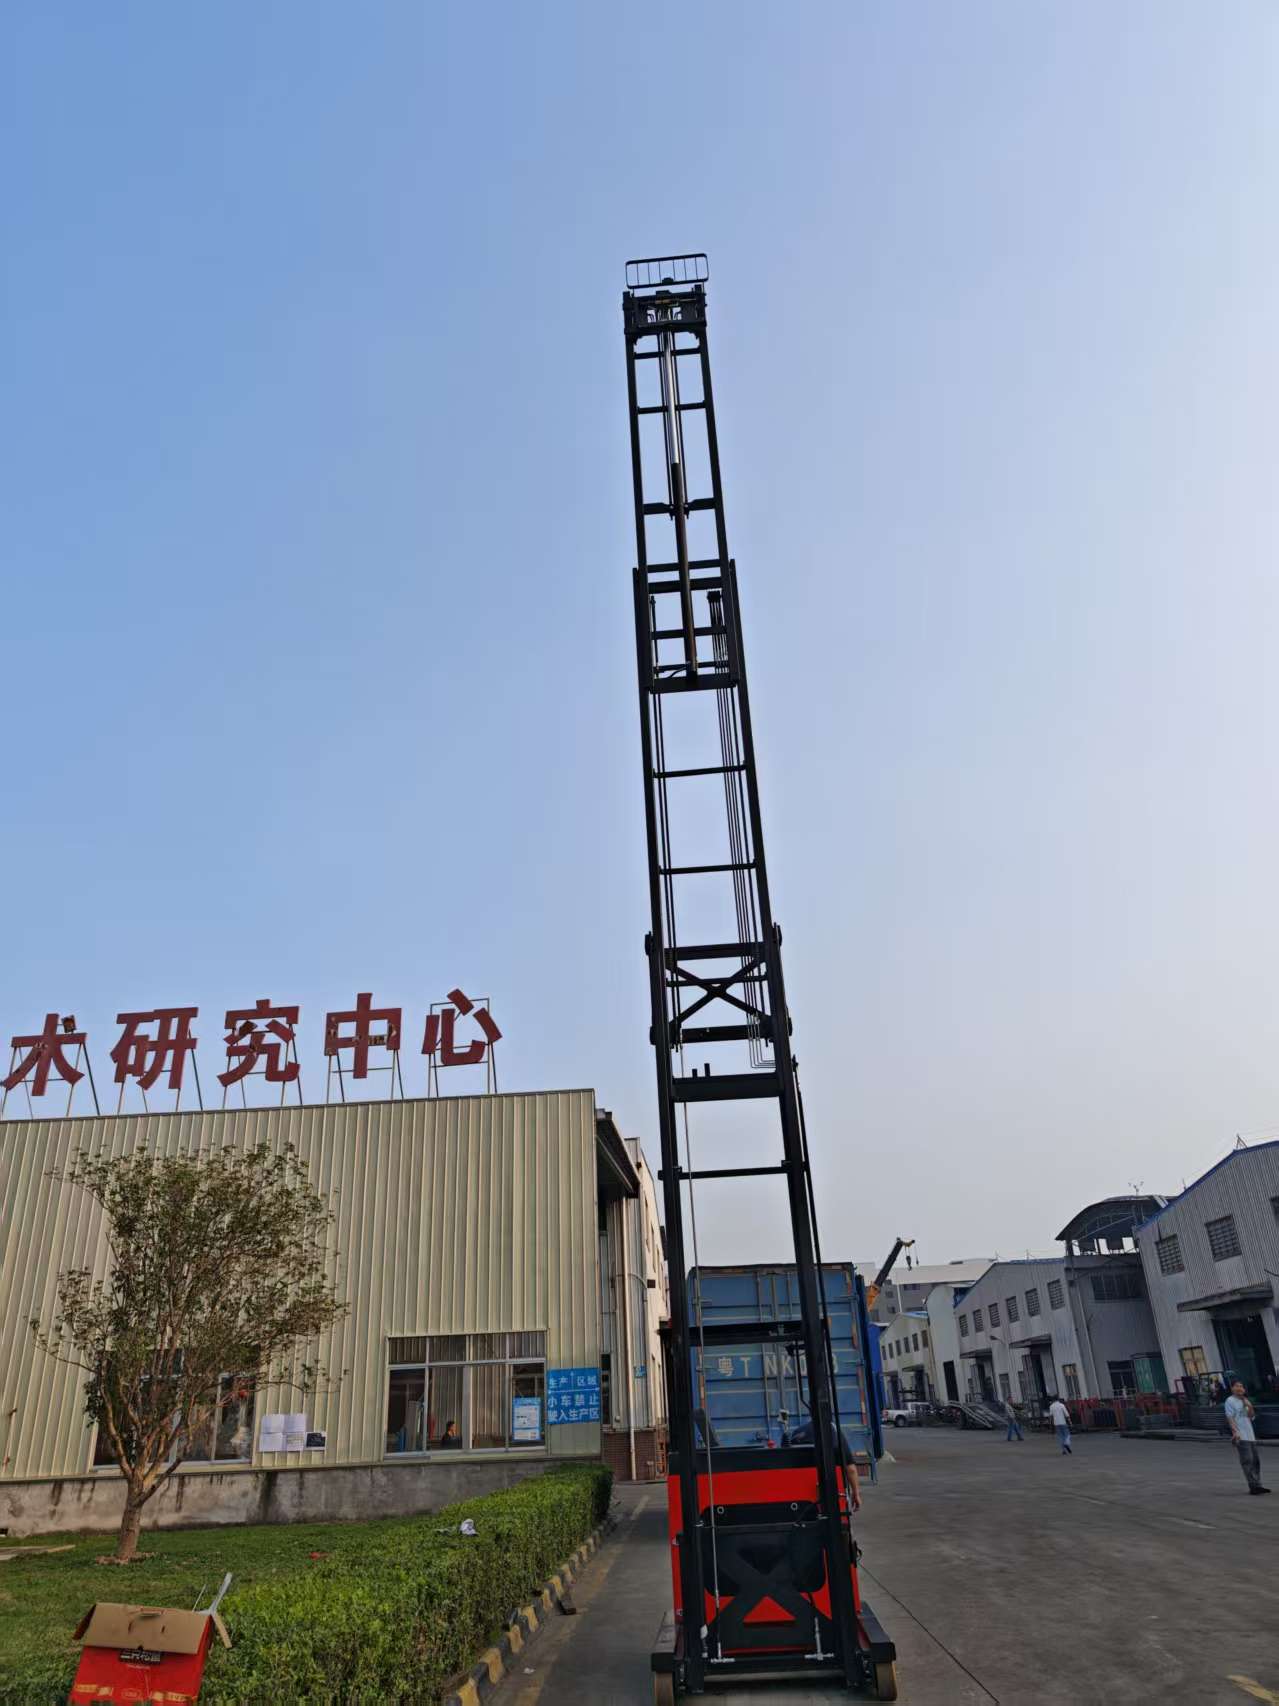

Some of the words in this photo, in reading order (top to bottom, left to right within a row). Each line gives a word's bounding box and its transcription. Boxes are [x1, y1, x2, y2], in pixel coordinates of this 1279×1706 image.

[0, 988, 502, 1096] 术研究中心
[548, 1393, 599, 1408] 小车禁止
